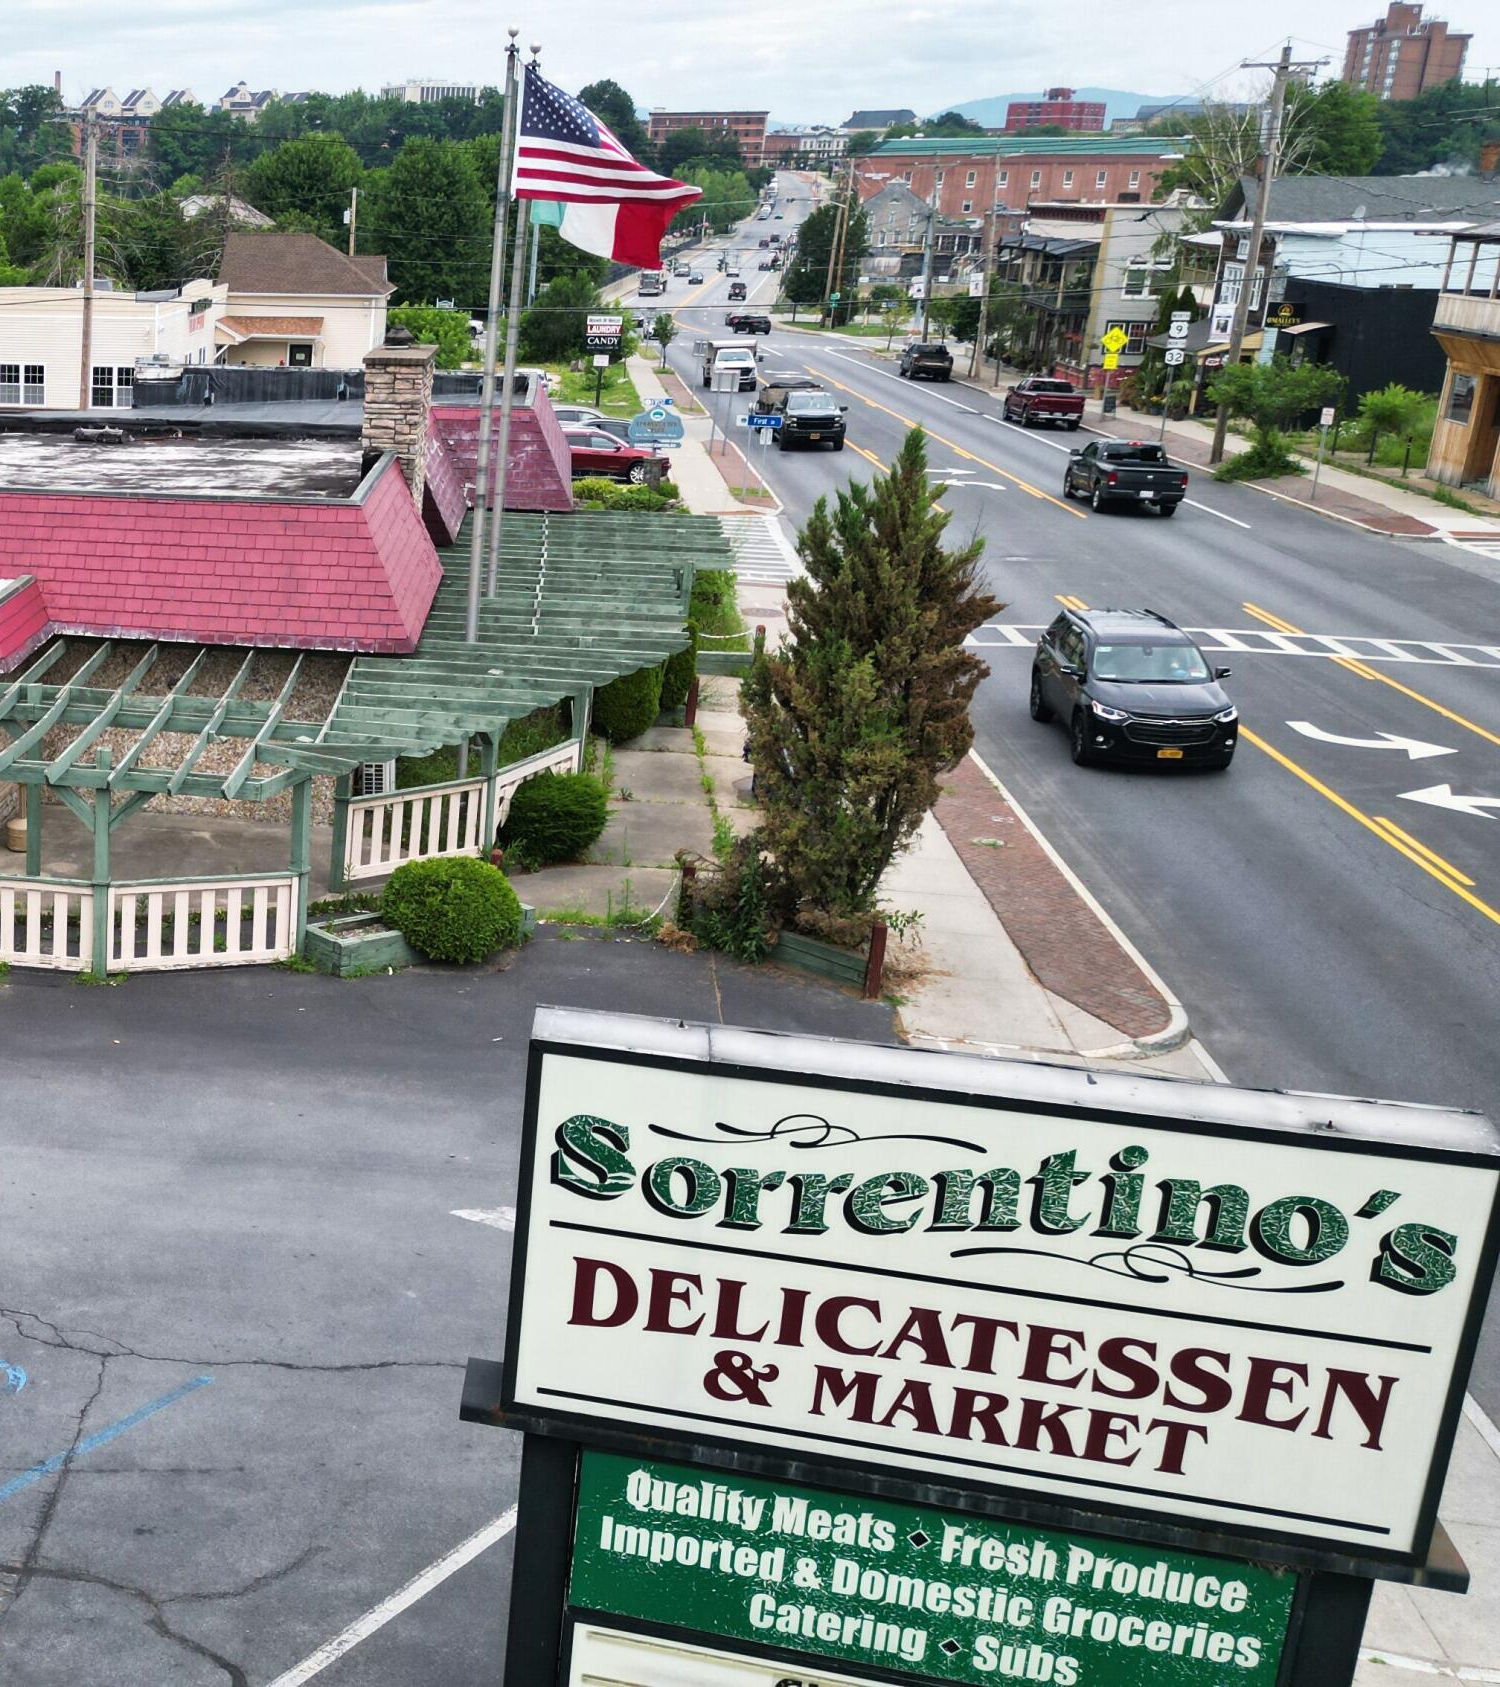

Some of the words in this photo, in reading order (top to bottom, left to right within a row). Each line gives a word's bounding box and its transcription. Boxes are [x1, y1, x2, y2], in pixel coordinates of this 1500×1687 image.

[587, 325, 621, 334] LAUNDRY
[587, 336, 620, 345] CANDY
[1166, 352, 1182, 362] 32
[1176, 325, 1183, 334] 9
[550, 1114, 1458, 1297] Sorrentino's
[567, 1257, 1400, 1452] DELICATESSEN
[703, 1350, 780, 1408] &
[808, 1364, 1209, 1476] MARKET
[600, 1515, 786, 1583] Imported
[793, 1557, 820, 1590] &
[832, 1558, 1034, 1627] Domestic
[1043, 1596, 1262, 1668] Groceries
[626, 1470, 767, 1531] Quality
[770, 1495, 896, 1552] Meats
[940, 1525, 1058, 1581] Fresh
[1066, 1547, 1248, 1613] Produce
[749, 1594, 927, 1662] Catering
[972, 1635, 1079, 1686] Subs
